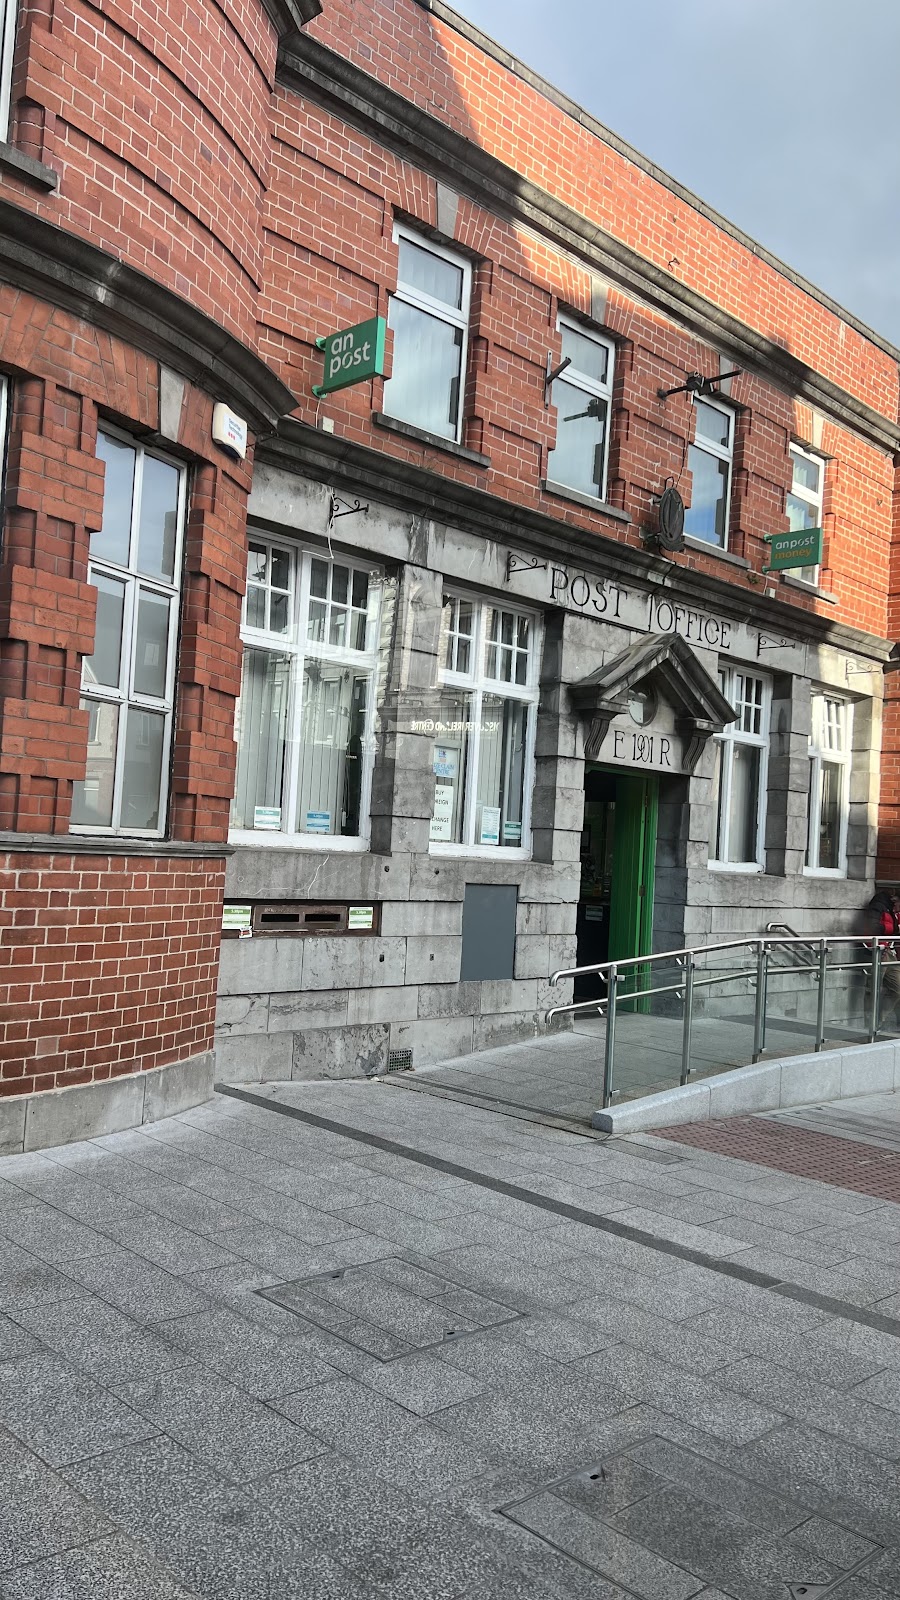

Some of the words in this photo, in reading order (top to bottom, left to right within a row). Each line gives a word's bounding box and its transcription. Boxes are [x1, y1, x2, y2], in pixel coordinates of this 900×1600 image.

[329, 341, 371, 379] post
[331, 333, 354, 355] an
[775, 548, 812, 559] money
[549, 567, 628, 618] POST
[656, 602, 731, 650] OFFICE
[613, 730, 626, 760] E
[632, 733, 654, 763] 1901
[659, 738, 671, 767] R
